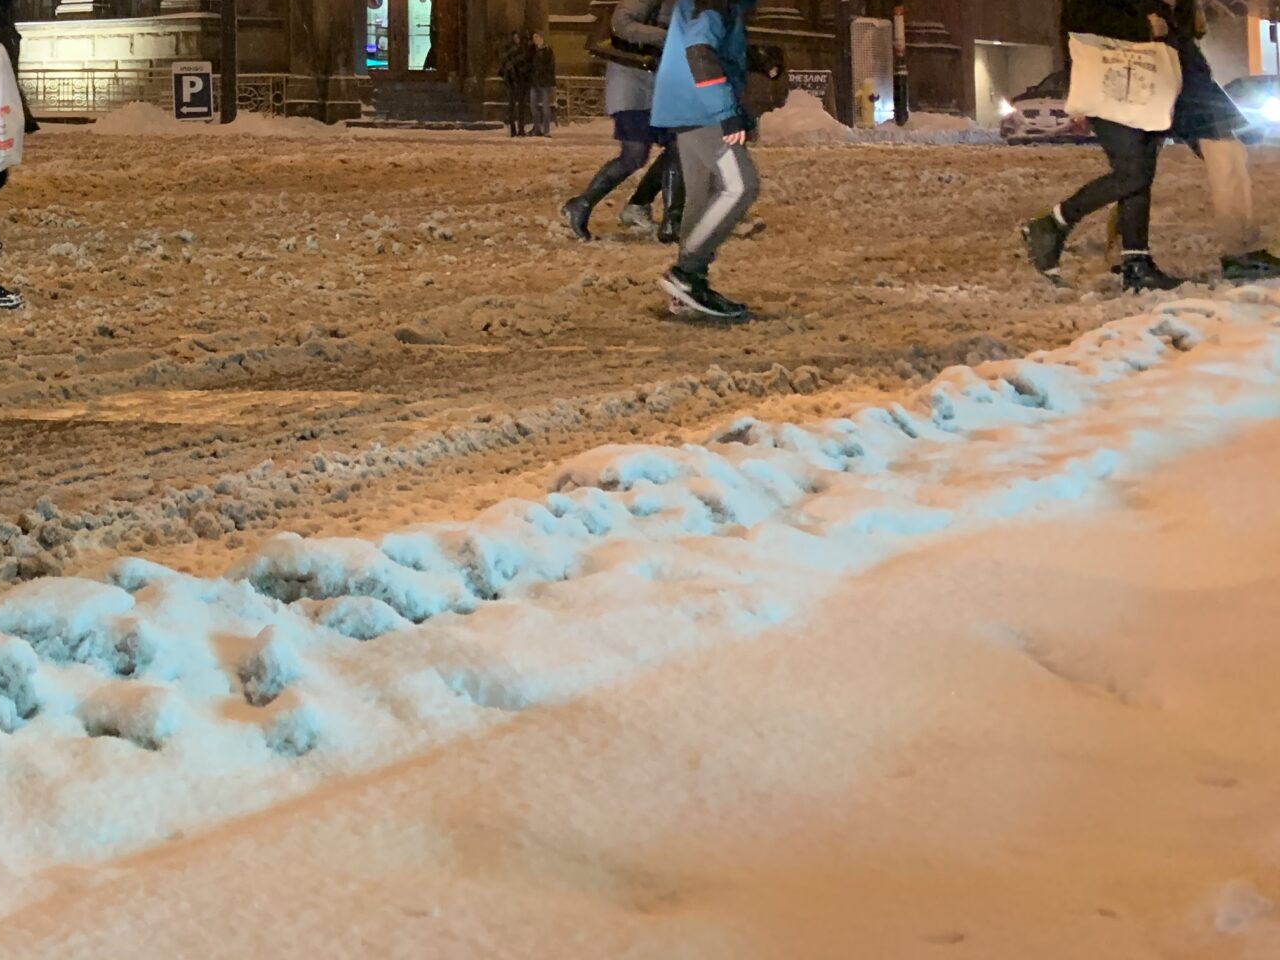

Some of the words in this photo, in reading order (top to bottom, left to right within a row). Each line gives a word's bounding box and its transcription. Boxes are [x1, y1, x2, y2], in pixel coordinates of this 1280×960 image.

[788, 74, 802, 83] THE
[803, 74, 827, 83] SAINT
[182, 75, 203, 103] P
